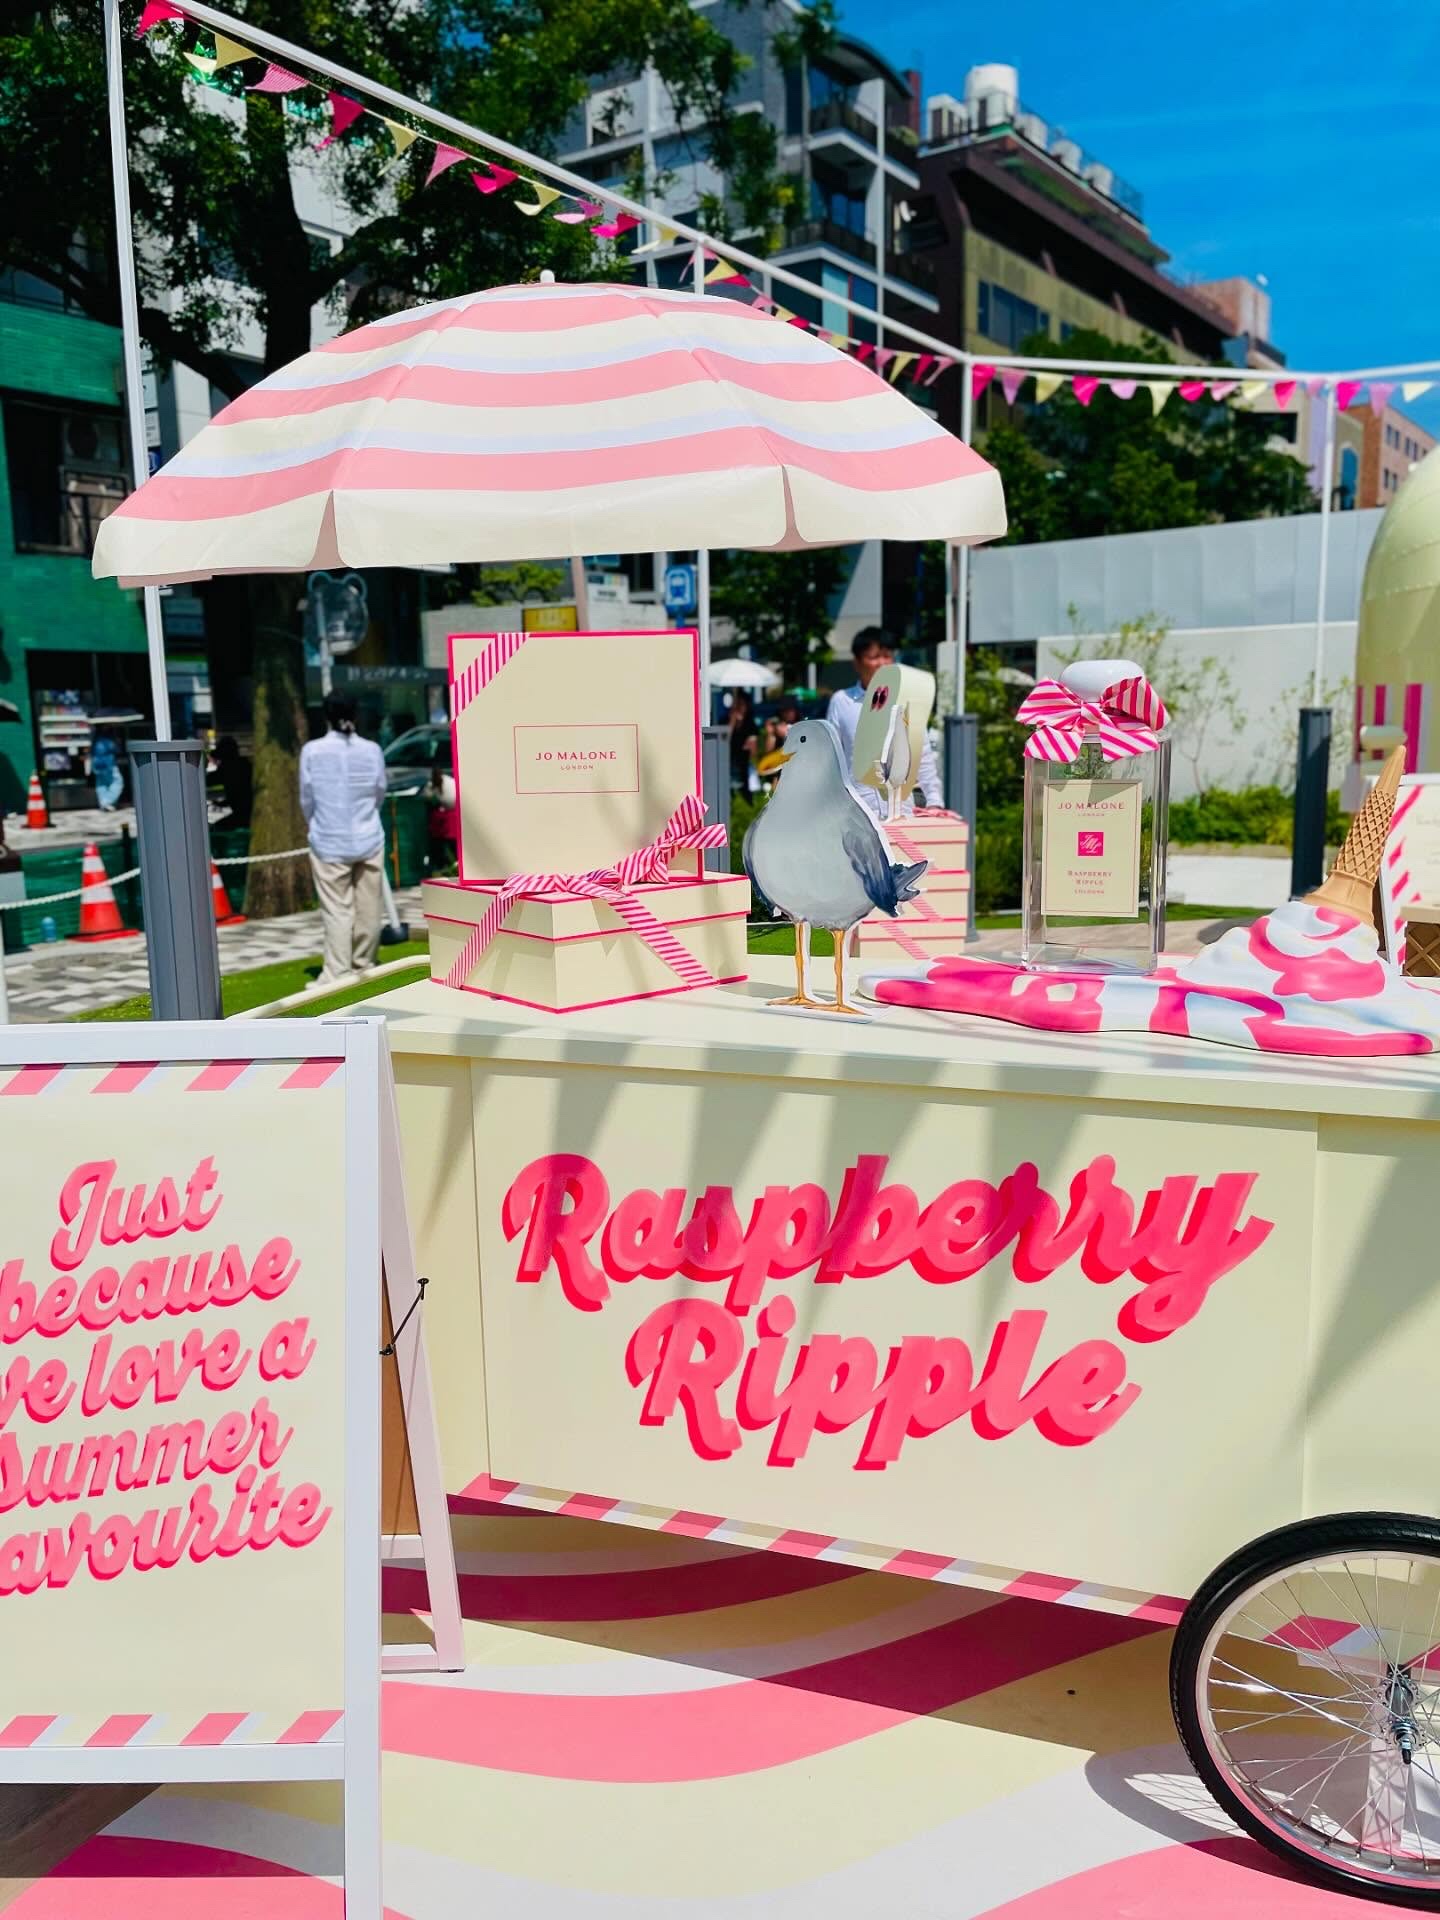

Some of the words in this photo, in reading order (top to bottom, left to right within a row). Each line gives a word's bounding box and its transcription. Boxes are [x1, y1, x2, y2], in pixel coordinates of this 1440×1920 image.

[535, 752, 552, 761] JO
[557, 751, 617, 760] MALONE
[1058, 802, 1072, 810] JO
[1076, 801, 1126, 810] MALONE
[50, 1155, 224, 1271] Just
[501, 1152, 1276, 1343] Raspberry
[0, 1236, 301, 1345] because
[81, 1328, 253, 1418] love
[258, 1316, 317, 1383] a
[625, 1294, 1142, 1471] Ripple
